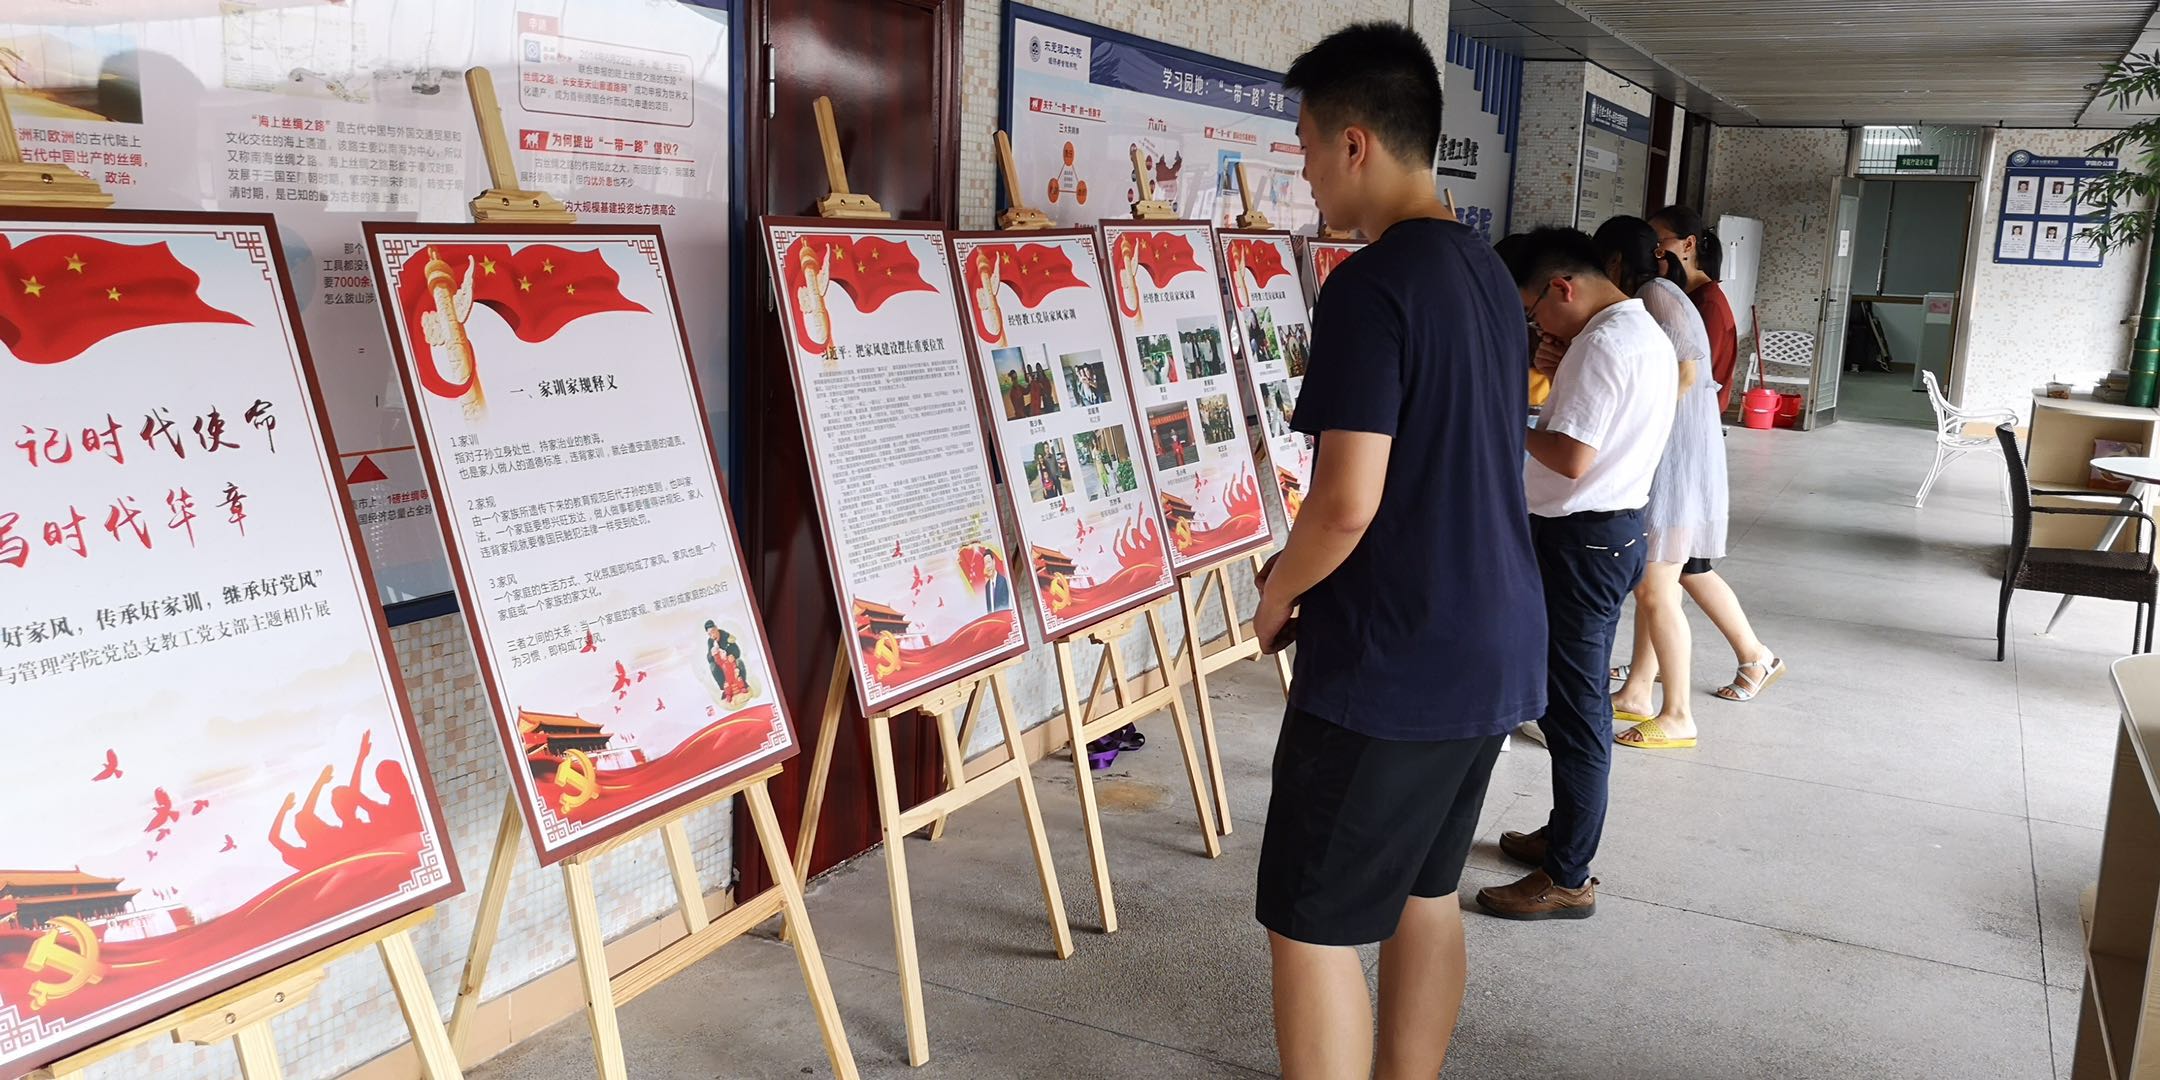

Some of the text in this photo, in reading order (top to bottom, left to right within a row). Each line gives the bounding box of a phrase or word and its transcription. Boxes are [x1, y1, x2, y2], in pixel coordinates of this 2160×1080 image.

[15, 127, 142, 149] 洲和欧洲的古代陆上
[323, 275, 375, 289] 要7000余
[323, 292, 378, 306] 怎么跋山涉
[1007, 308, 1078, 327] 经管教工党员家风家训
[509, 374, 619, 400] 一、家训家规释义
[15, 399, 276, 467] 记时代使命
[450, 433, 480, 449] 1.家训
[467, 496, 497, 512] 2.家规
[489, 573, 518, 589] 3.家风
[497, 588, 602, 622] 家庭或一个家族的家文化。
[510, 635, 607, 669] 为习惯，即构成了风。
